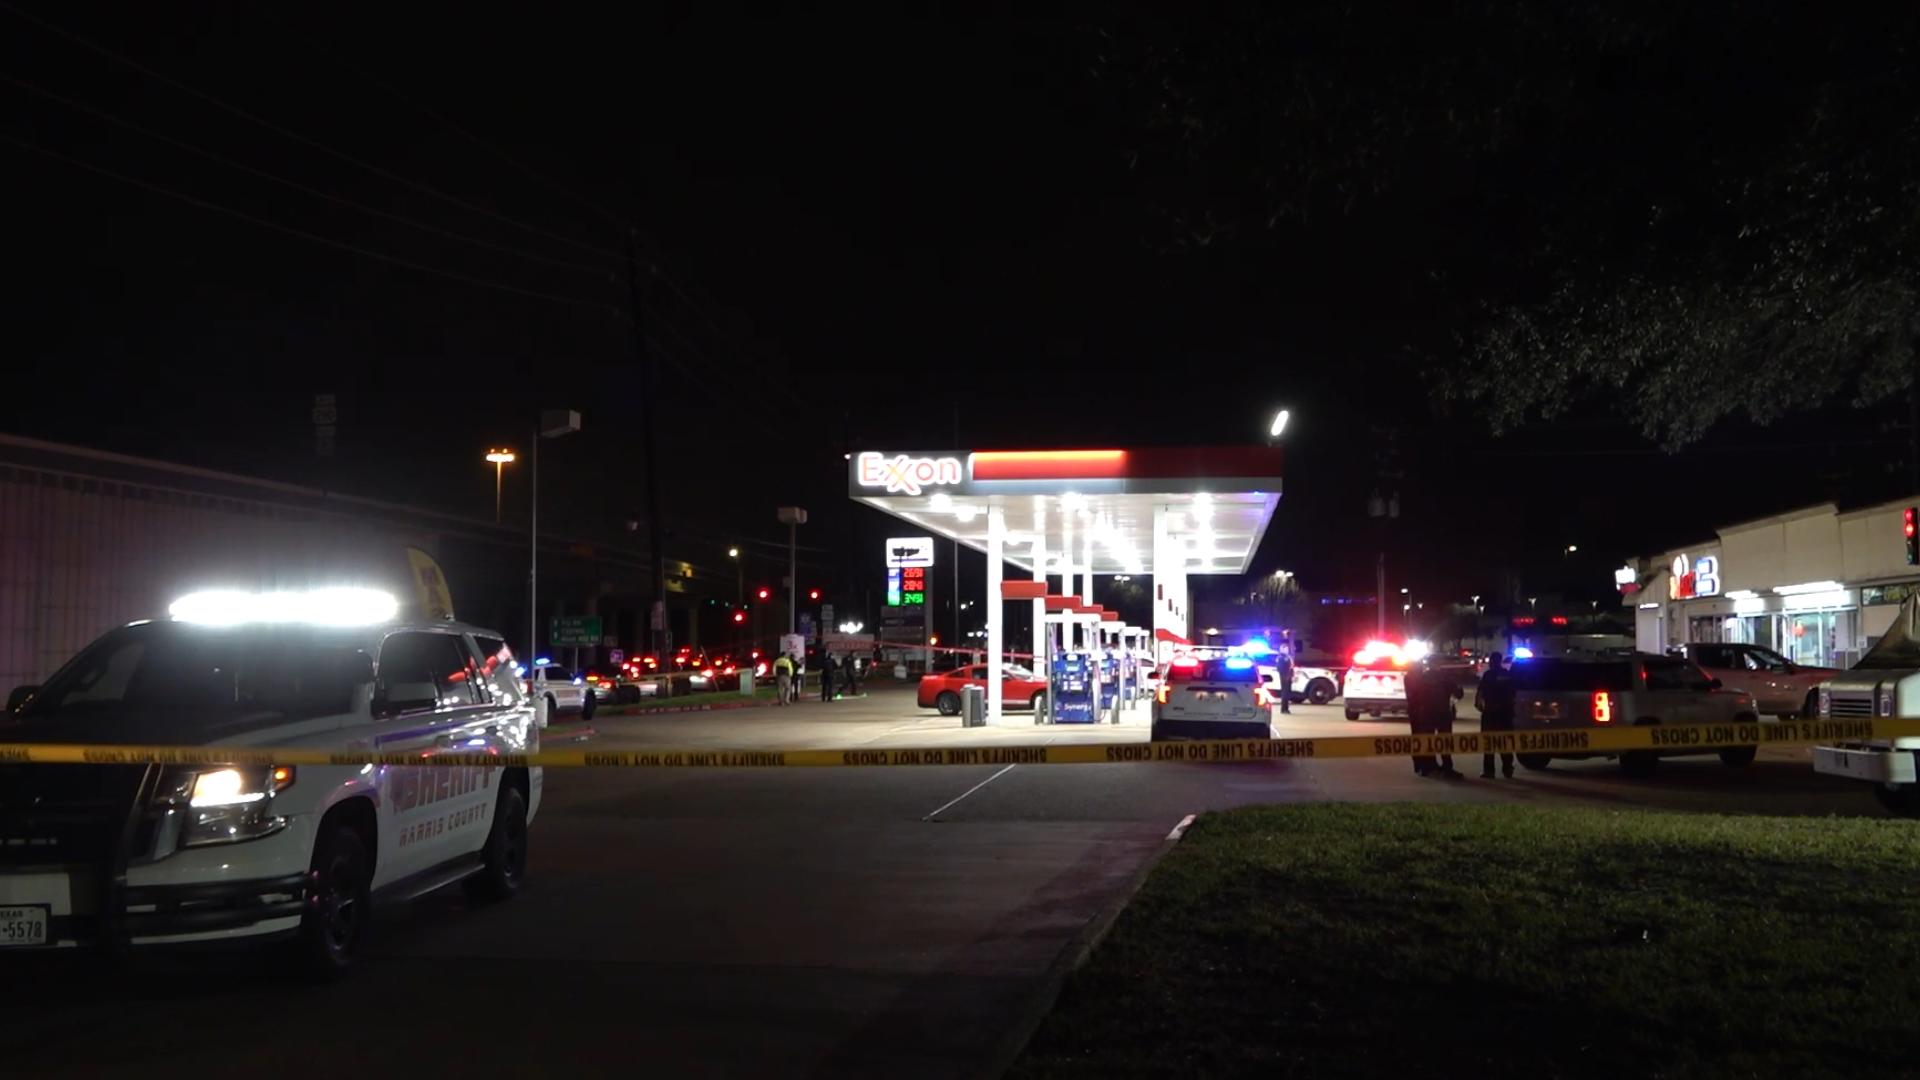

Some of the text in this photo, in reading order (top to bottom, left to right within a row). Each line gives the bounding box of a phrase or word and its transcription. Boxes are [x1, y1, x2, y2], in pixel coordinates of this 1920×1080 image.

[860, 453, 960, 493] Exxon
[1375, 731, 1589, 754] SHERIFFS LINE DO NOT CROSS
[1651, 720, 1873, 745] SHERIFFS LINE DO NOT CROSS
[844, 748, 1046, 765] SHERIFFS LINE DO NOT CROSS
[1106, 741, 1314, 760] SHERIFFS LINE DO NOT CROSS
[399, 803, 487, 847] HARRIS COUNTY
